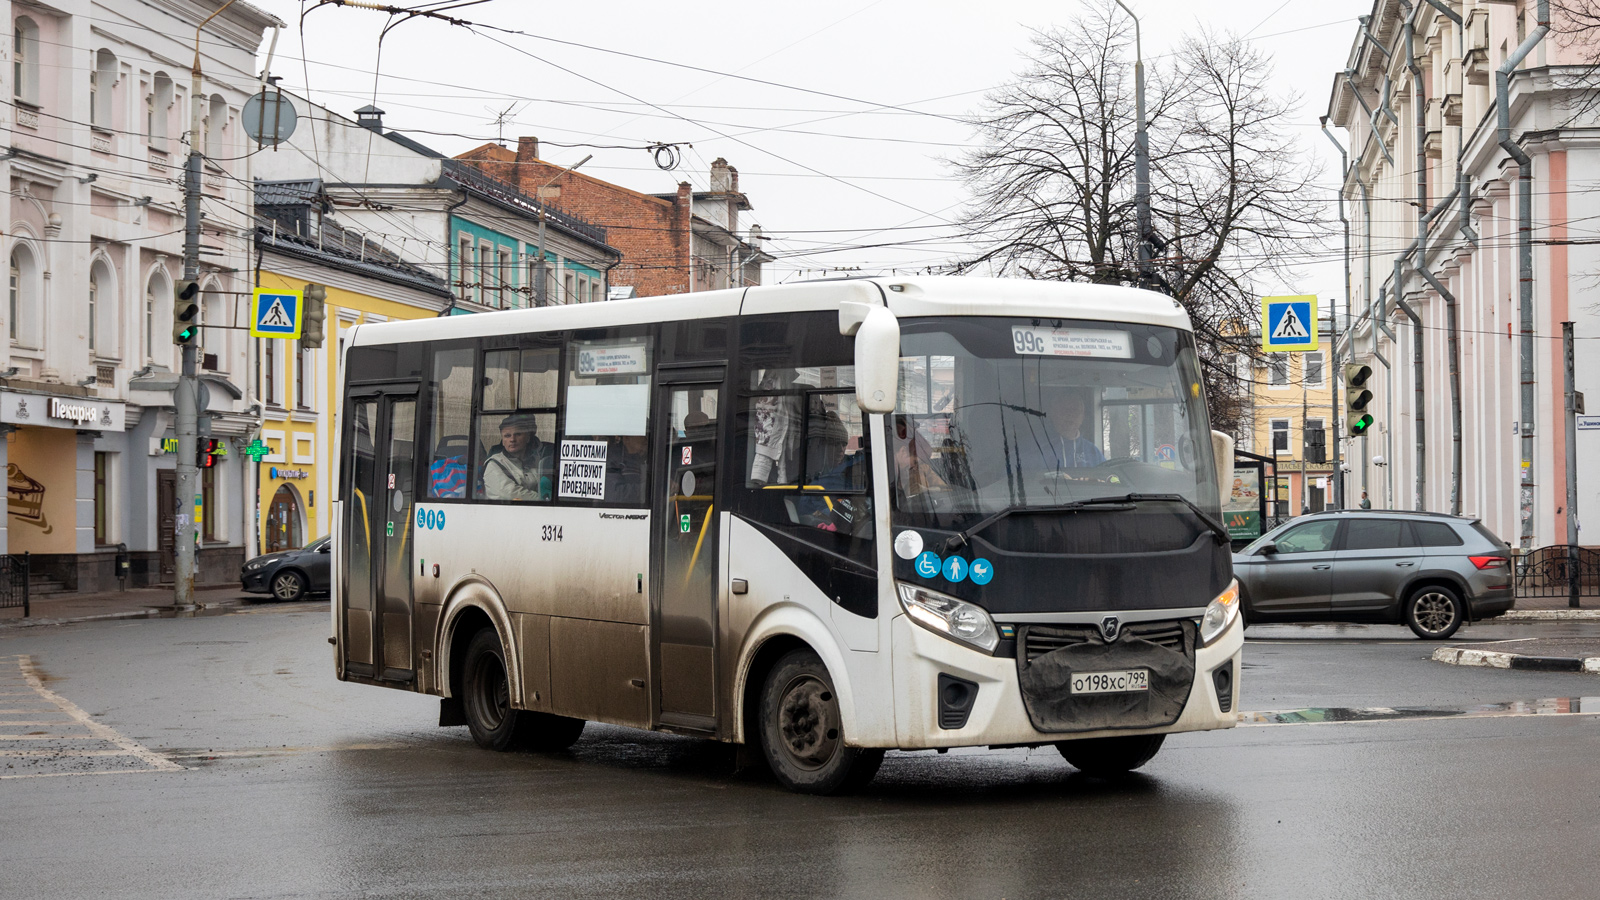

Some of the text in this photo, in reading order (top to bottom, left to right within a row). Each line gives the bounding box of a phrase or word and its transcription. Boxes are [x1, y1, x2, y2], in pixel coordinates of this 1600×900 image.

[51, 397, 97, 426] Пекарня
[562, 444, 606, 459] СО ЛЬГОТАМИ
[562, 462, 603, 480] ДЕЙСТВУЮТ
[562, 480, 602, 497] ПРОЕЗДНЫЕ
[542, 525, 563, 542] 3314
[1075, 672, 1145, 691] О198ХС 799
